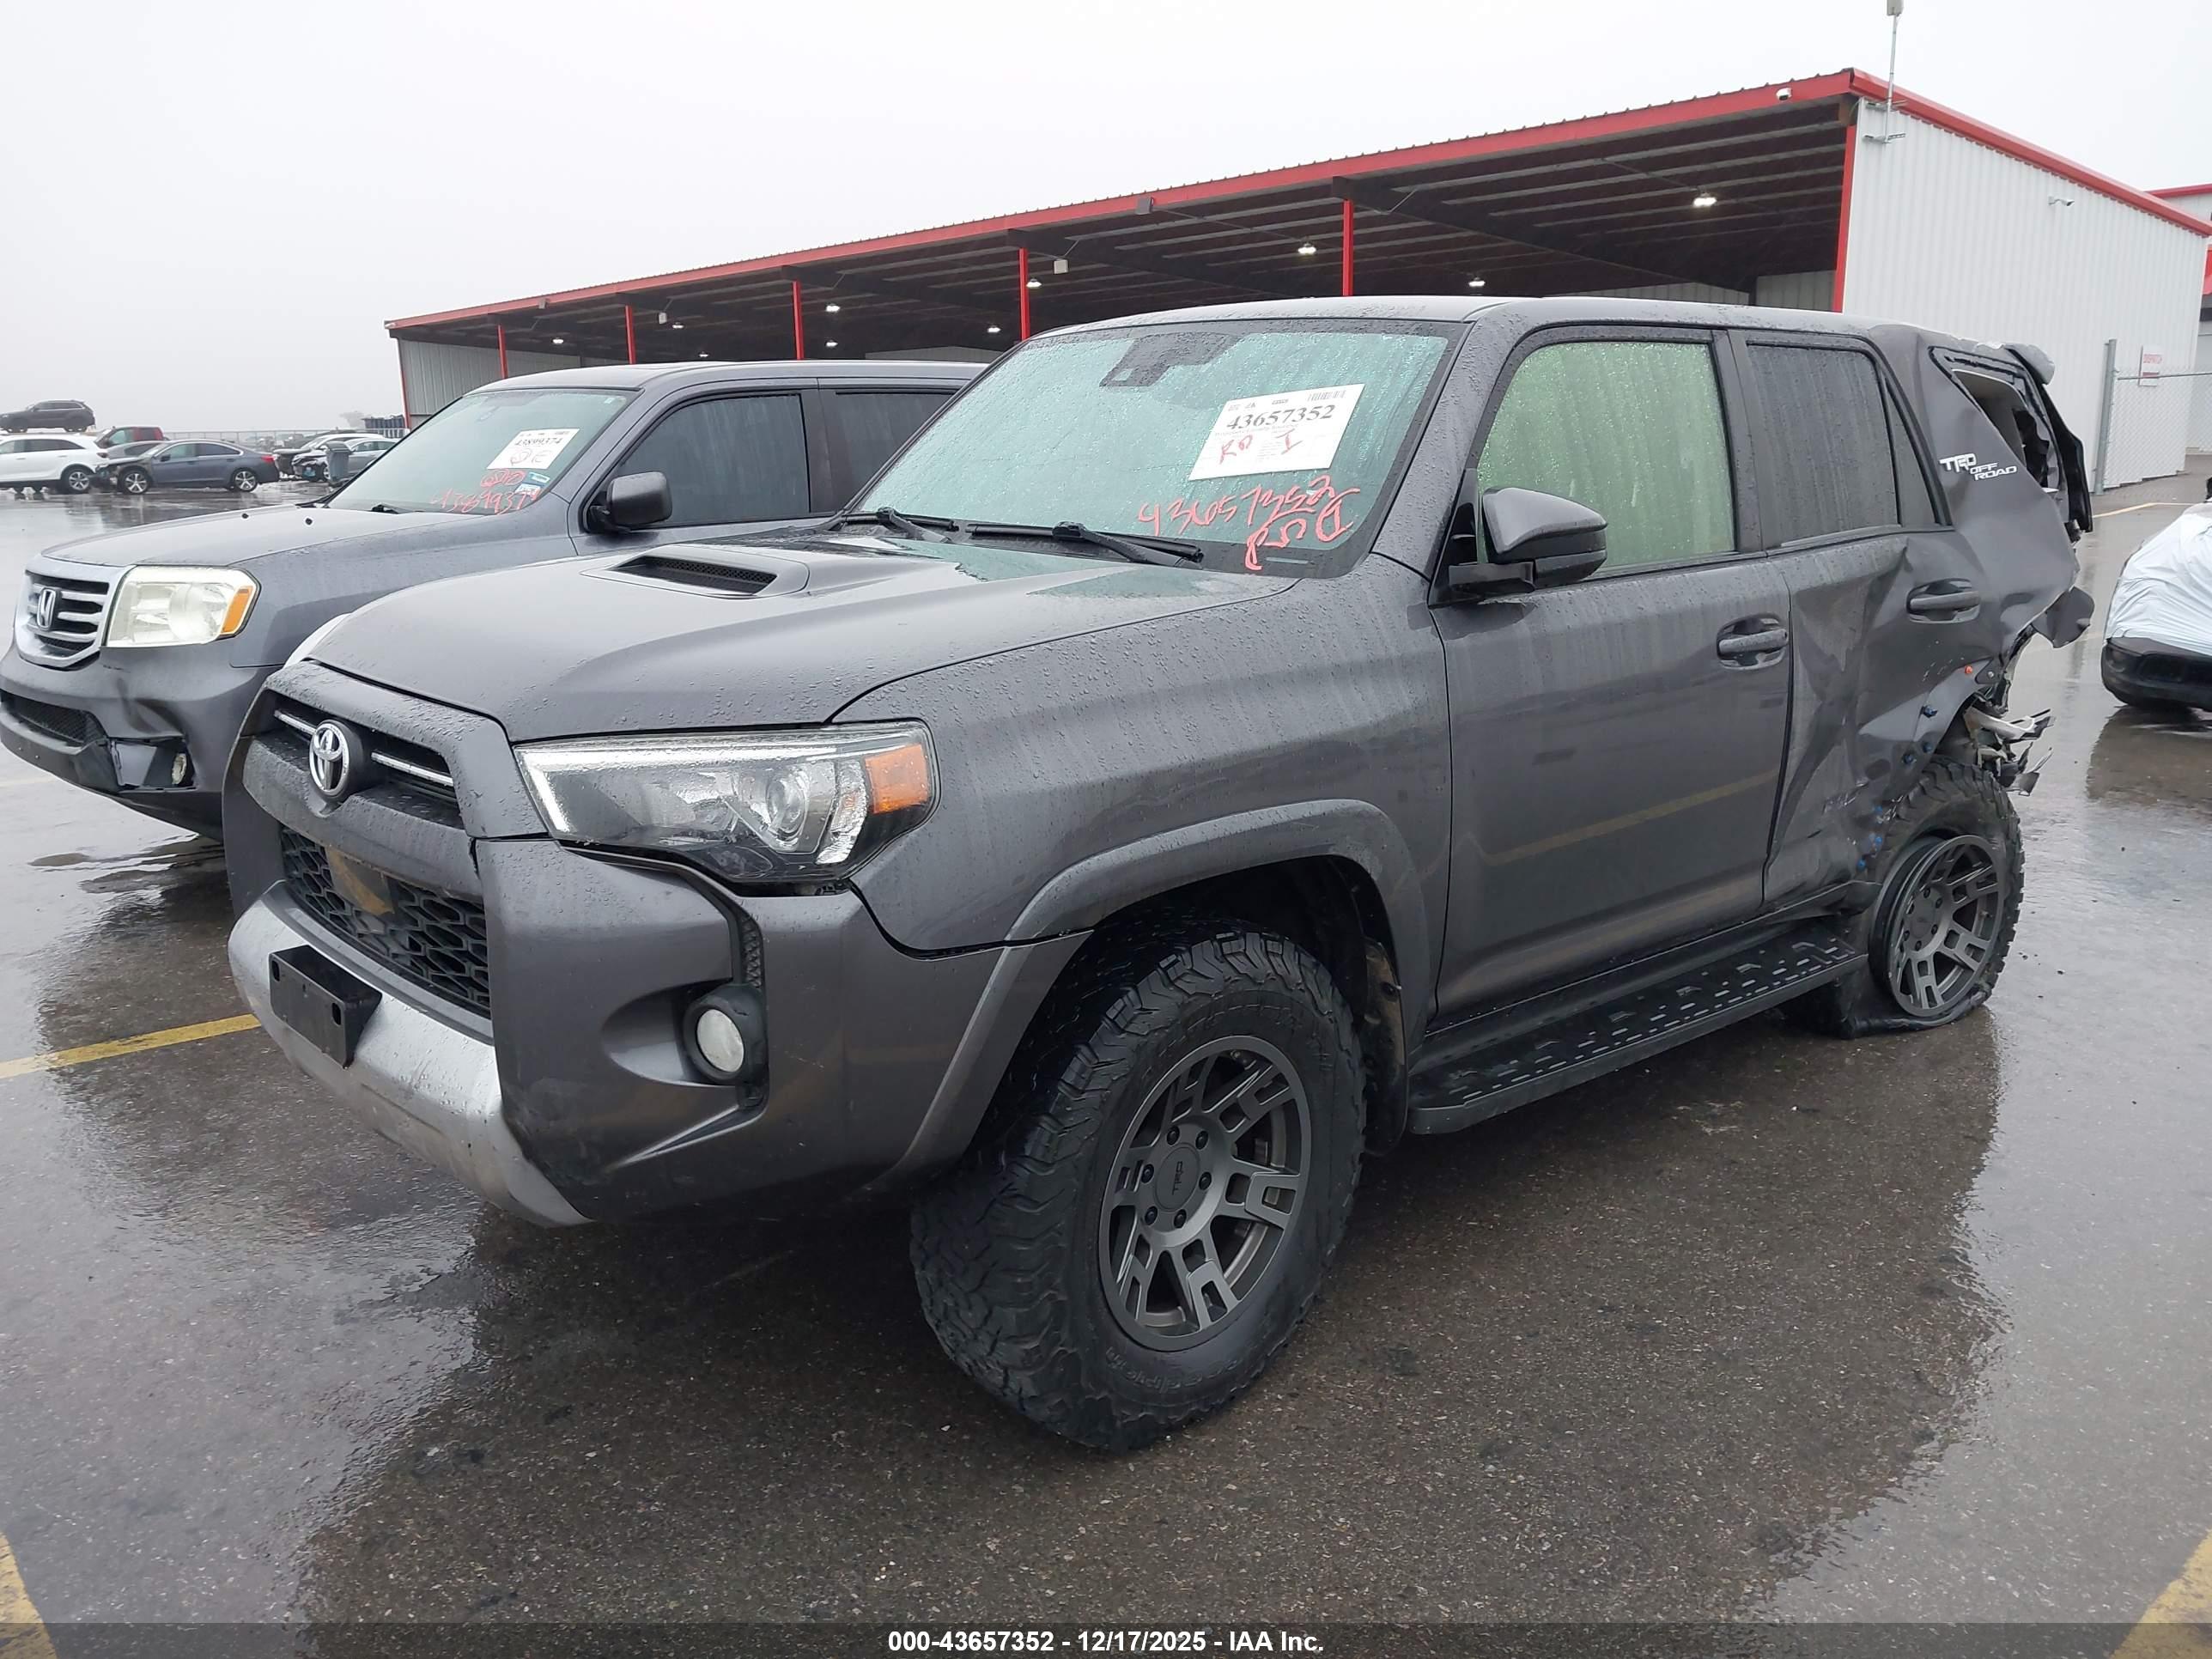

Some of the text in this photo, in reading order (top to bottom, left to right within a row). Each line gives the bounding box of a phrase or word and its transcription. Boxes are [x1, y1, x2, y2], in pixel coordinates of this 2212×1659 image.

[1226, 404, 1336, 430] 43657352
[1939, 453, 1998, 475] TRD OFF
[1975, 466, 2017, 481] ROAD
